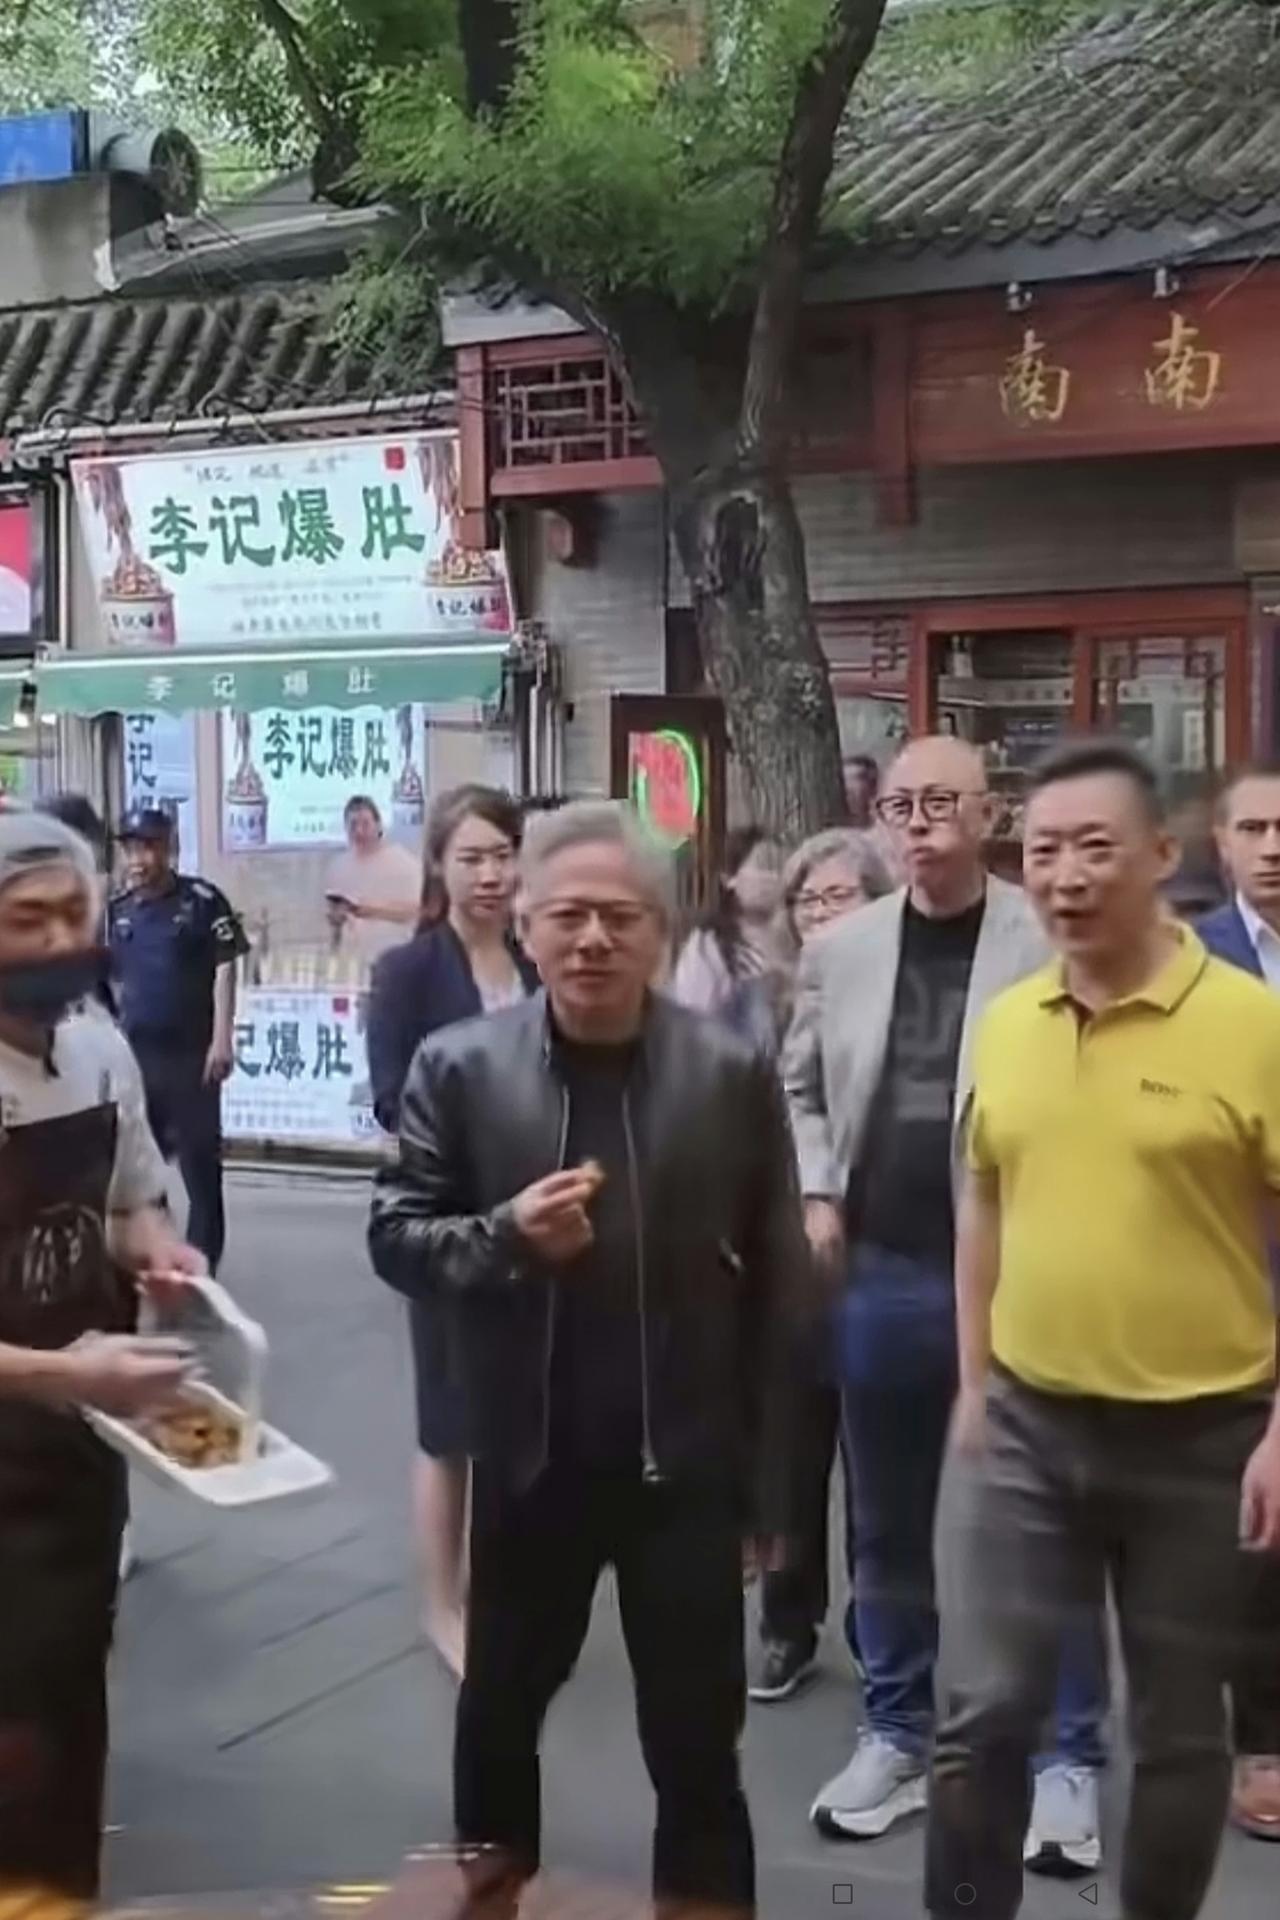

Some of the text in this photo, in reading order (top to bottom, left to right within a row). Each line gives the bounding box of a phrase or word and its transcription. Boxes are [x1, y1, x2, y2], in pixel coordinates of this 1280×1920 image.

[149, 483, 425, 575] 李记爆肚
[264, 713, 390, 780] 李记爆肚
